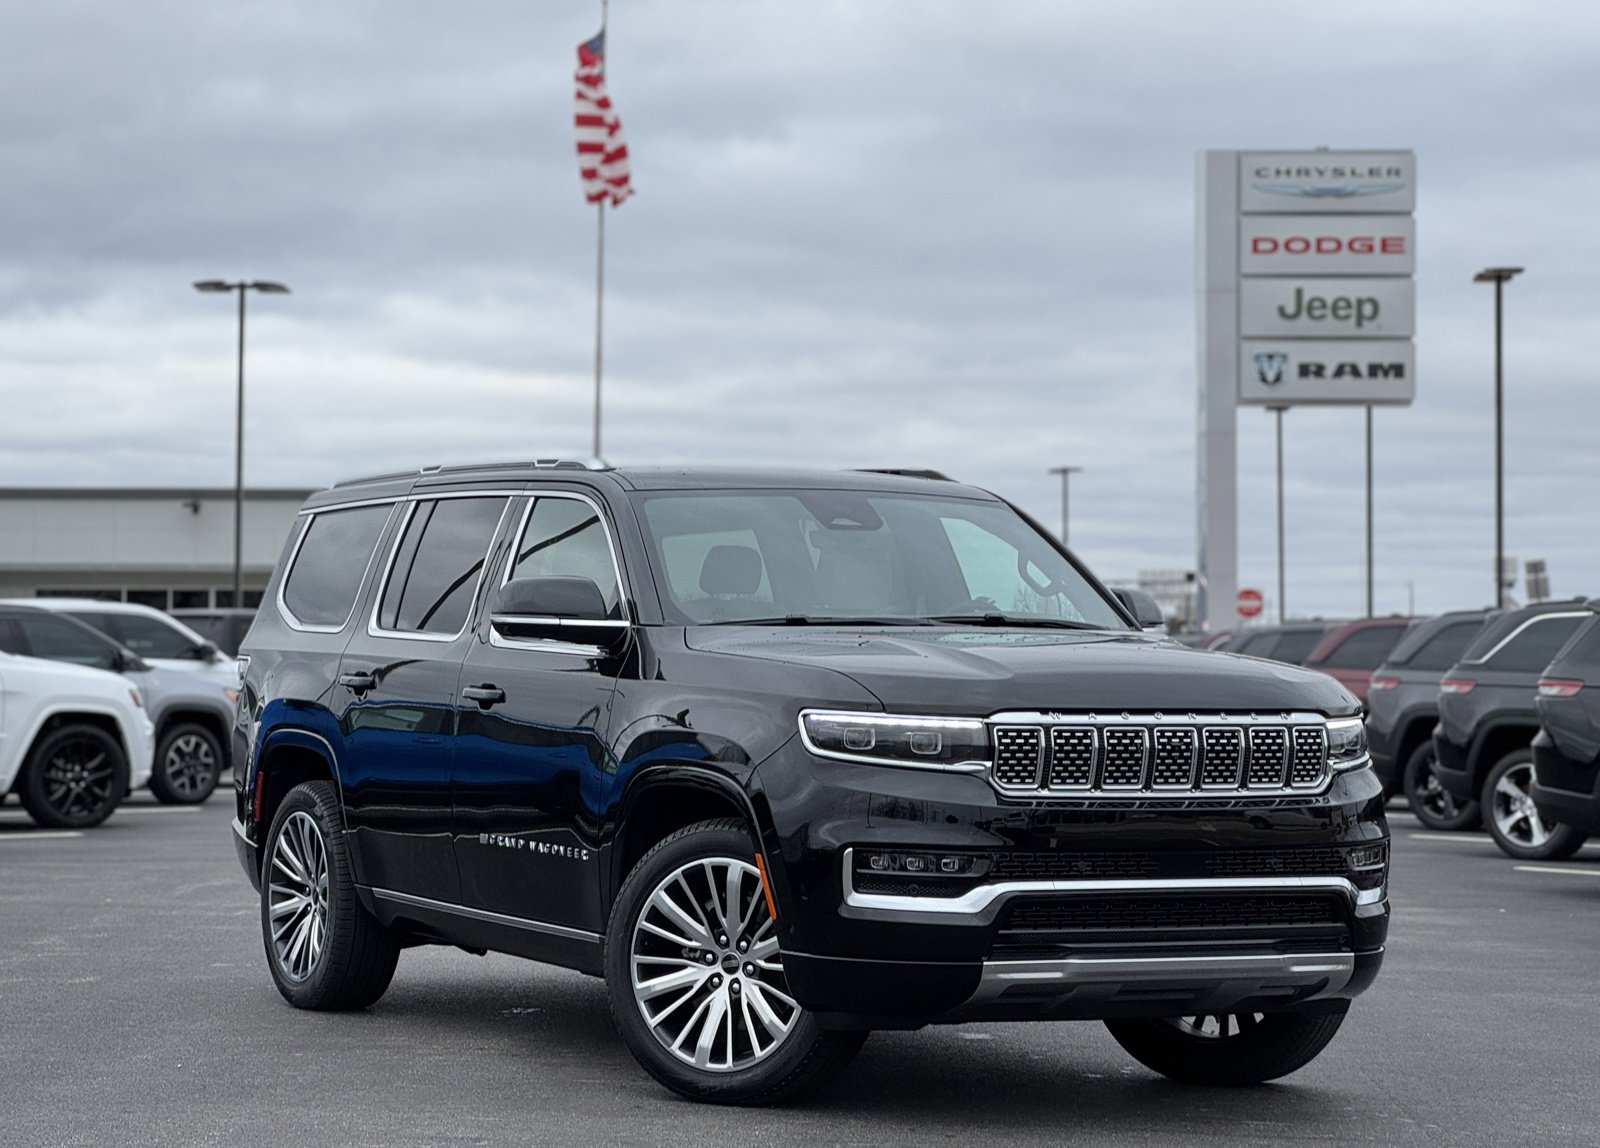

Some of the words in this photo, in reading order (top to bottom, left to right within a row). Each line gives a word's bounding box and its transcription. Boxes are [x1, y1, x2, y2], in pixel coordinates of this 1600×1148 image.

[1254, 166, 1402, 179] CHRYSLER
[1252, 236, 1406, 255] DODGE
[1277, 287, 1381, 328] Jeep
[1297, 362, 1405, 380] RAM
[1049, 711, 1289, 721] WAGONEER
